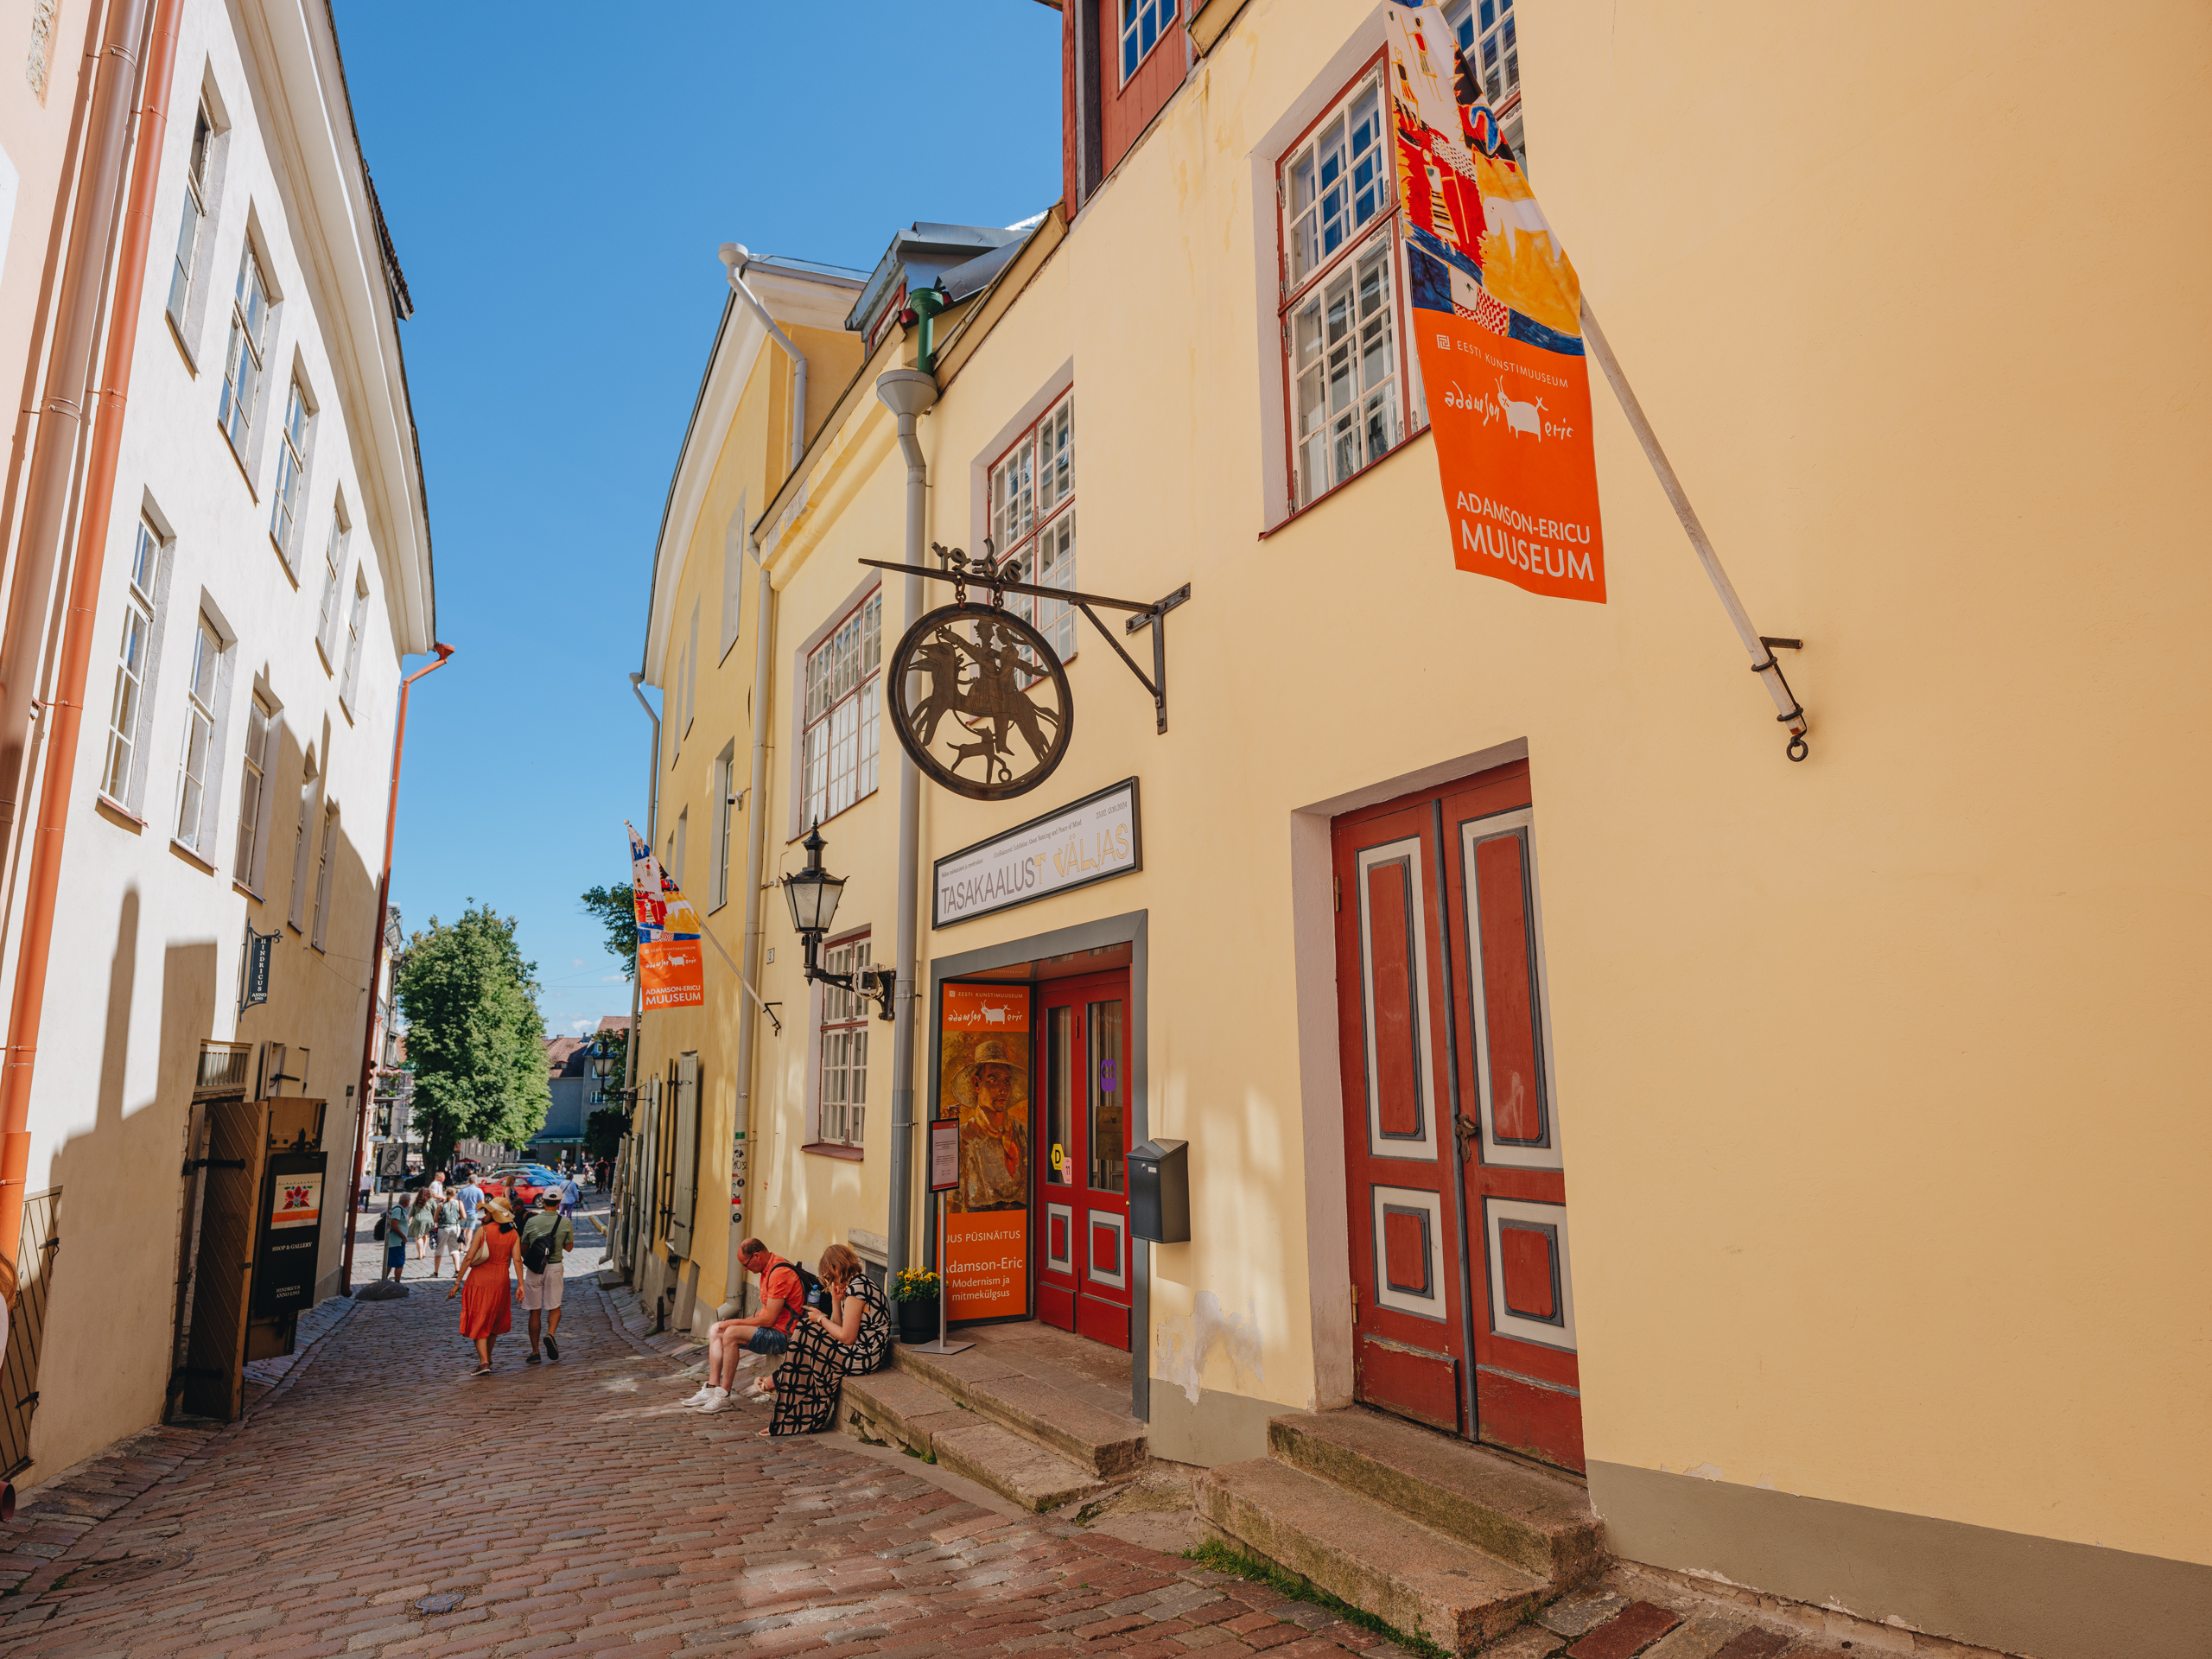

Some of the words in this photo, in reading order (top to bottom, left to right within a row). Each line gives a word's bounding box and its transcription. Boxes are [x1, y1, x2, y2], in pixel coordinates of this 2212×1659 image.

[1457, 340, 1482, 358] EESTI
[1485, 353, 1568, 388] KUNSTIMUUSEUM
[1545, 418, 1574, 440] eric
[1456, 490, 1590, 544] ADAMSON-ERICU
[1462, 519, 1594, 582] MUUSEUM
[1028, 836, 1037, 845] About
[1037, 832, 1051, 842] Noticing
[1058, 825, 1068, 834] Peace
[941, 852, 1046, 915] TASAKAALUST
[1053, 823, 1129, 877] VÄLJAS
[257, 939, 267, 992] HINDRICUS
[645, 985, 700, 995] ADAMSON-ERICU
[645, 992, 701, 1006] MUUSEUM
[1007, 1011, 1023, 1021] eric
[1055, 1150, 1061, 1164] D
[966, 1230, 1020, 1242] PÜSINÄITUS
[952, 1277, 1000, 1288] Modernism
[1002, 1276, 1010, 1287] ja
[952, 1289, 1010, 1301] mitmekülgsus
